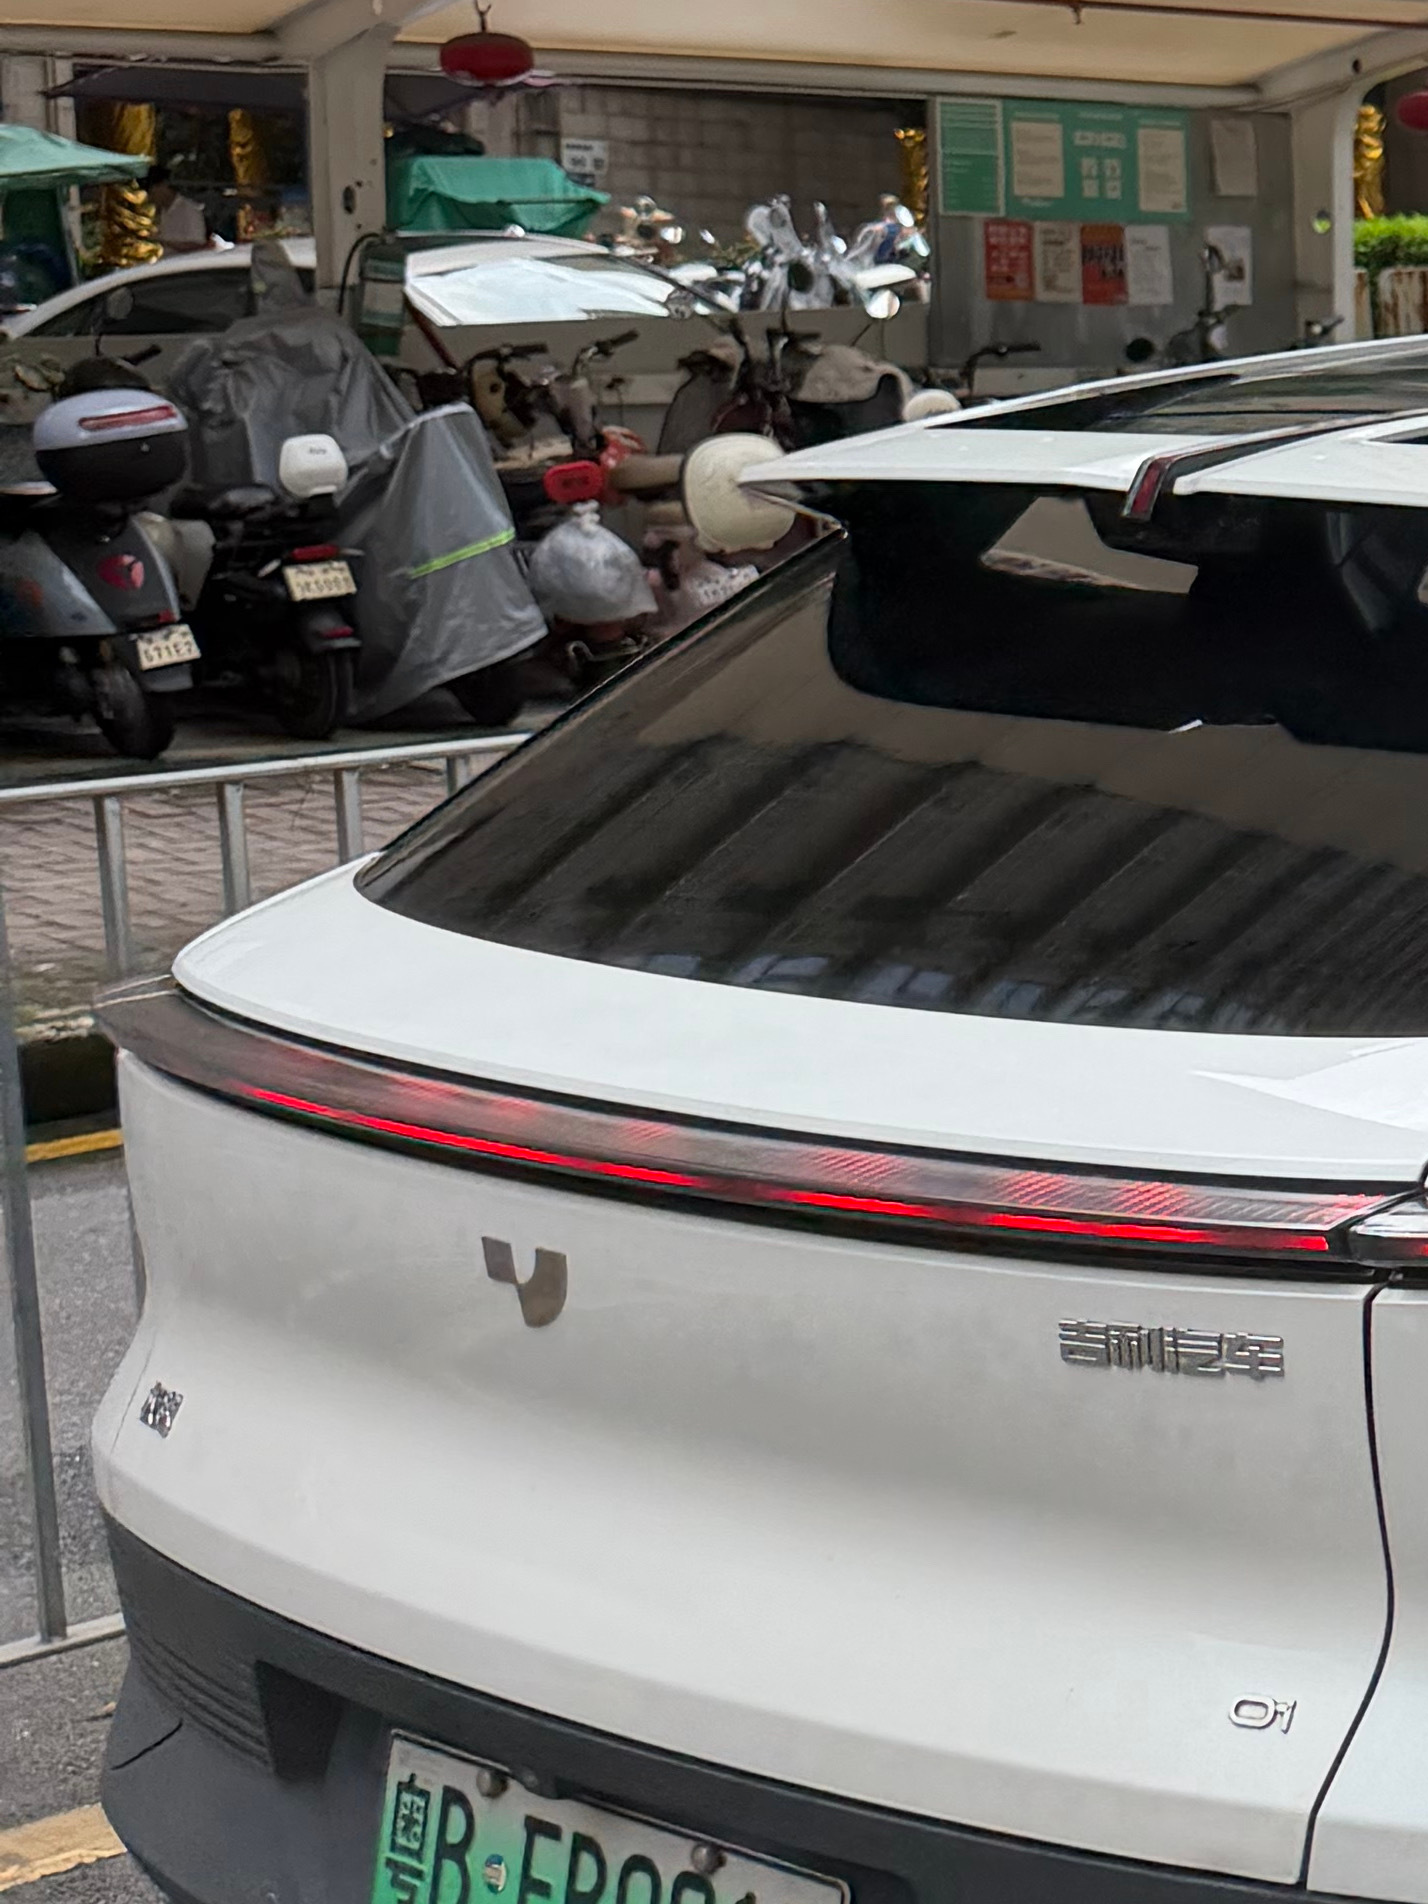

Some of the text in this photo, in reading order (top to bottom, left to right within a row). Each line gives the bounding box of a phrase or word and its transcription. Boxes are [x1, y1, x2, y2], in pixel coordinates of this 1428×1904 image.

[1058, 1318, 1284, 1381] 吉利汽车
[1228, 1693, 1298, 1735] 01
